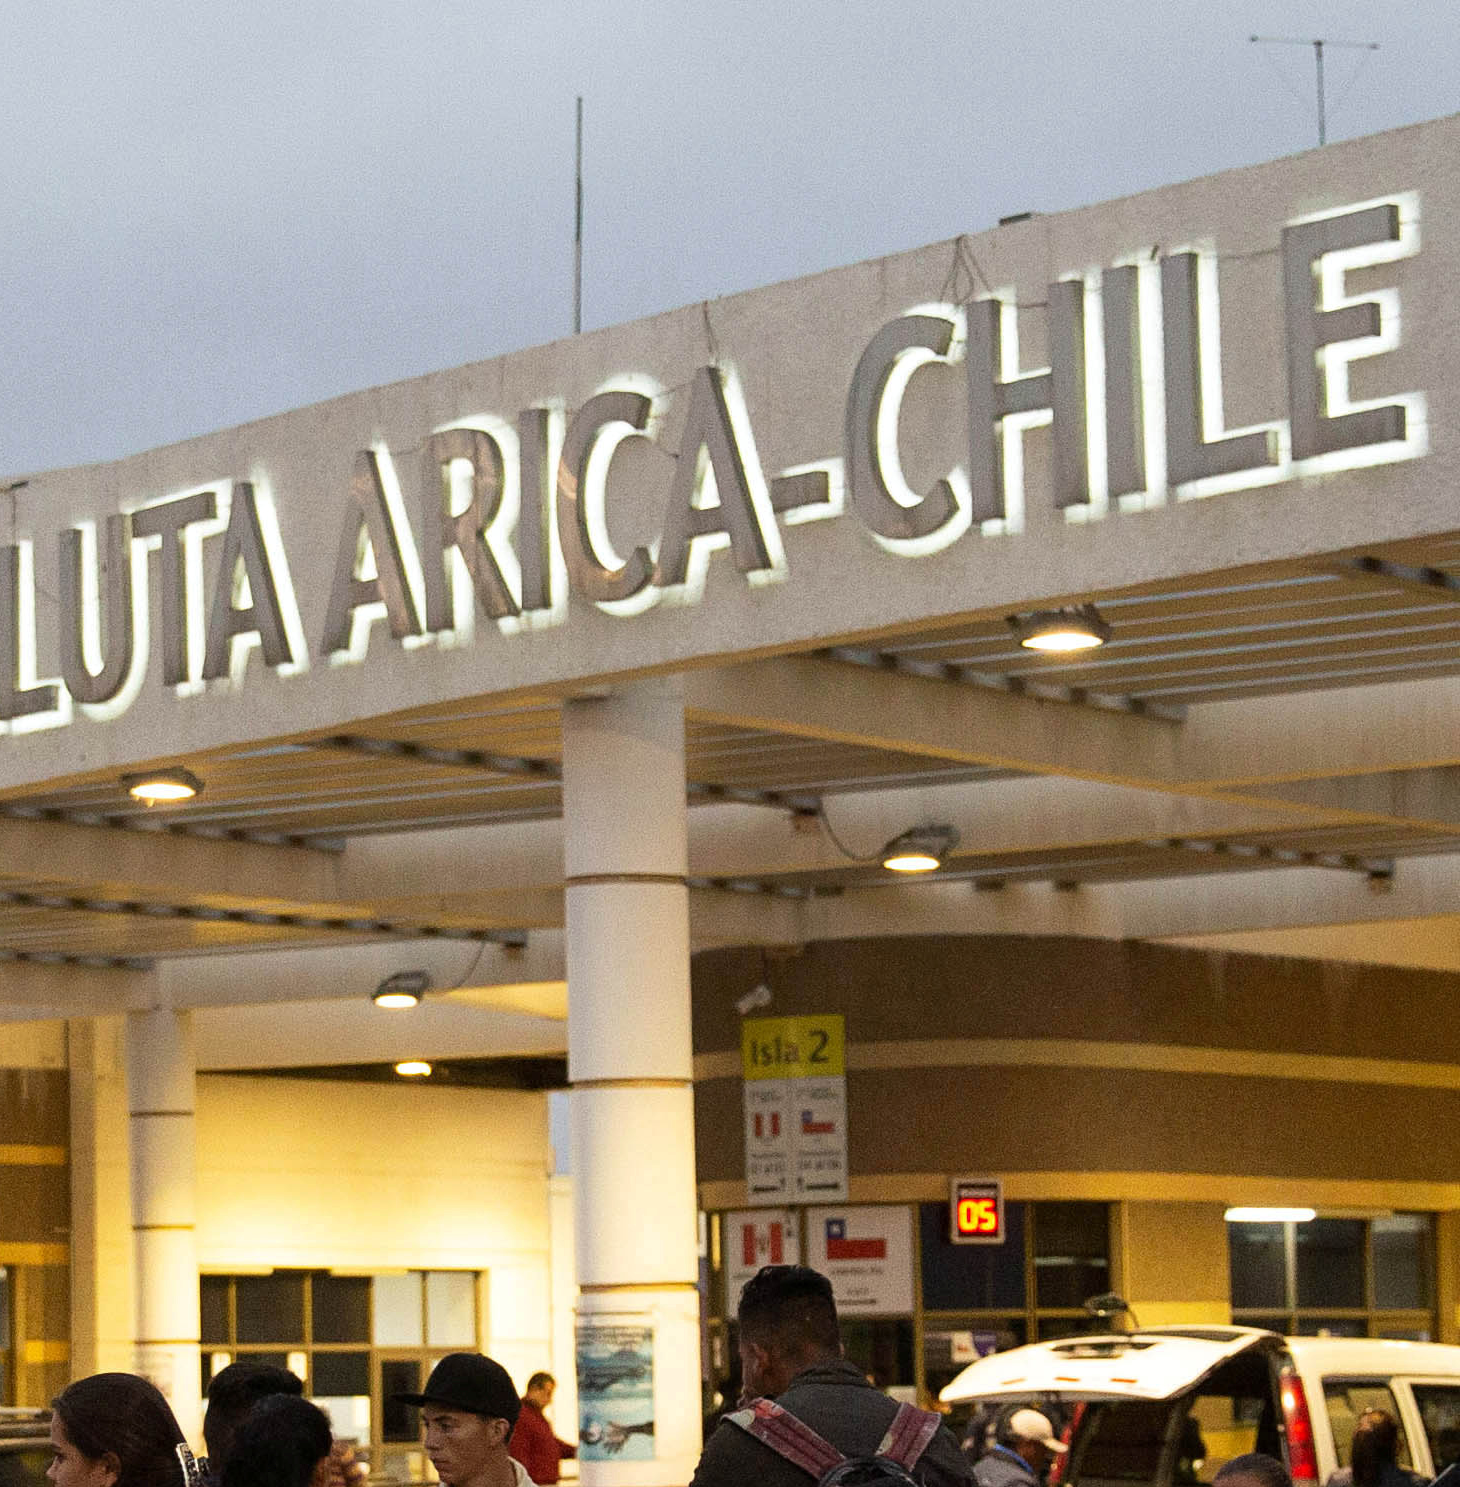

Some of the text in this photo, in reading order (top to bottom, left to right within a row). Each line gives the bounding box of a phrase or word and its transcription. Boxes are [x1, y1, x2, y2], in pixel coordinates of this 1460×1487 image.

[322, 192, 1427, 662] ARICA-CHILE
[751, 1029, 829, 1067] Isla 2
[957, 1199, 1000, 1233] 05
